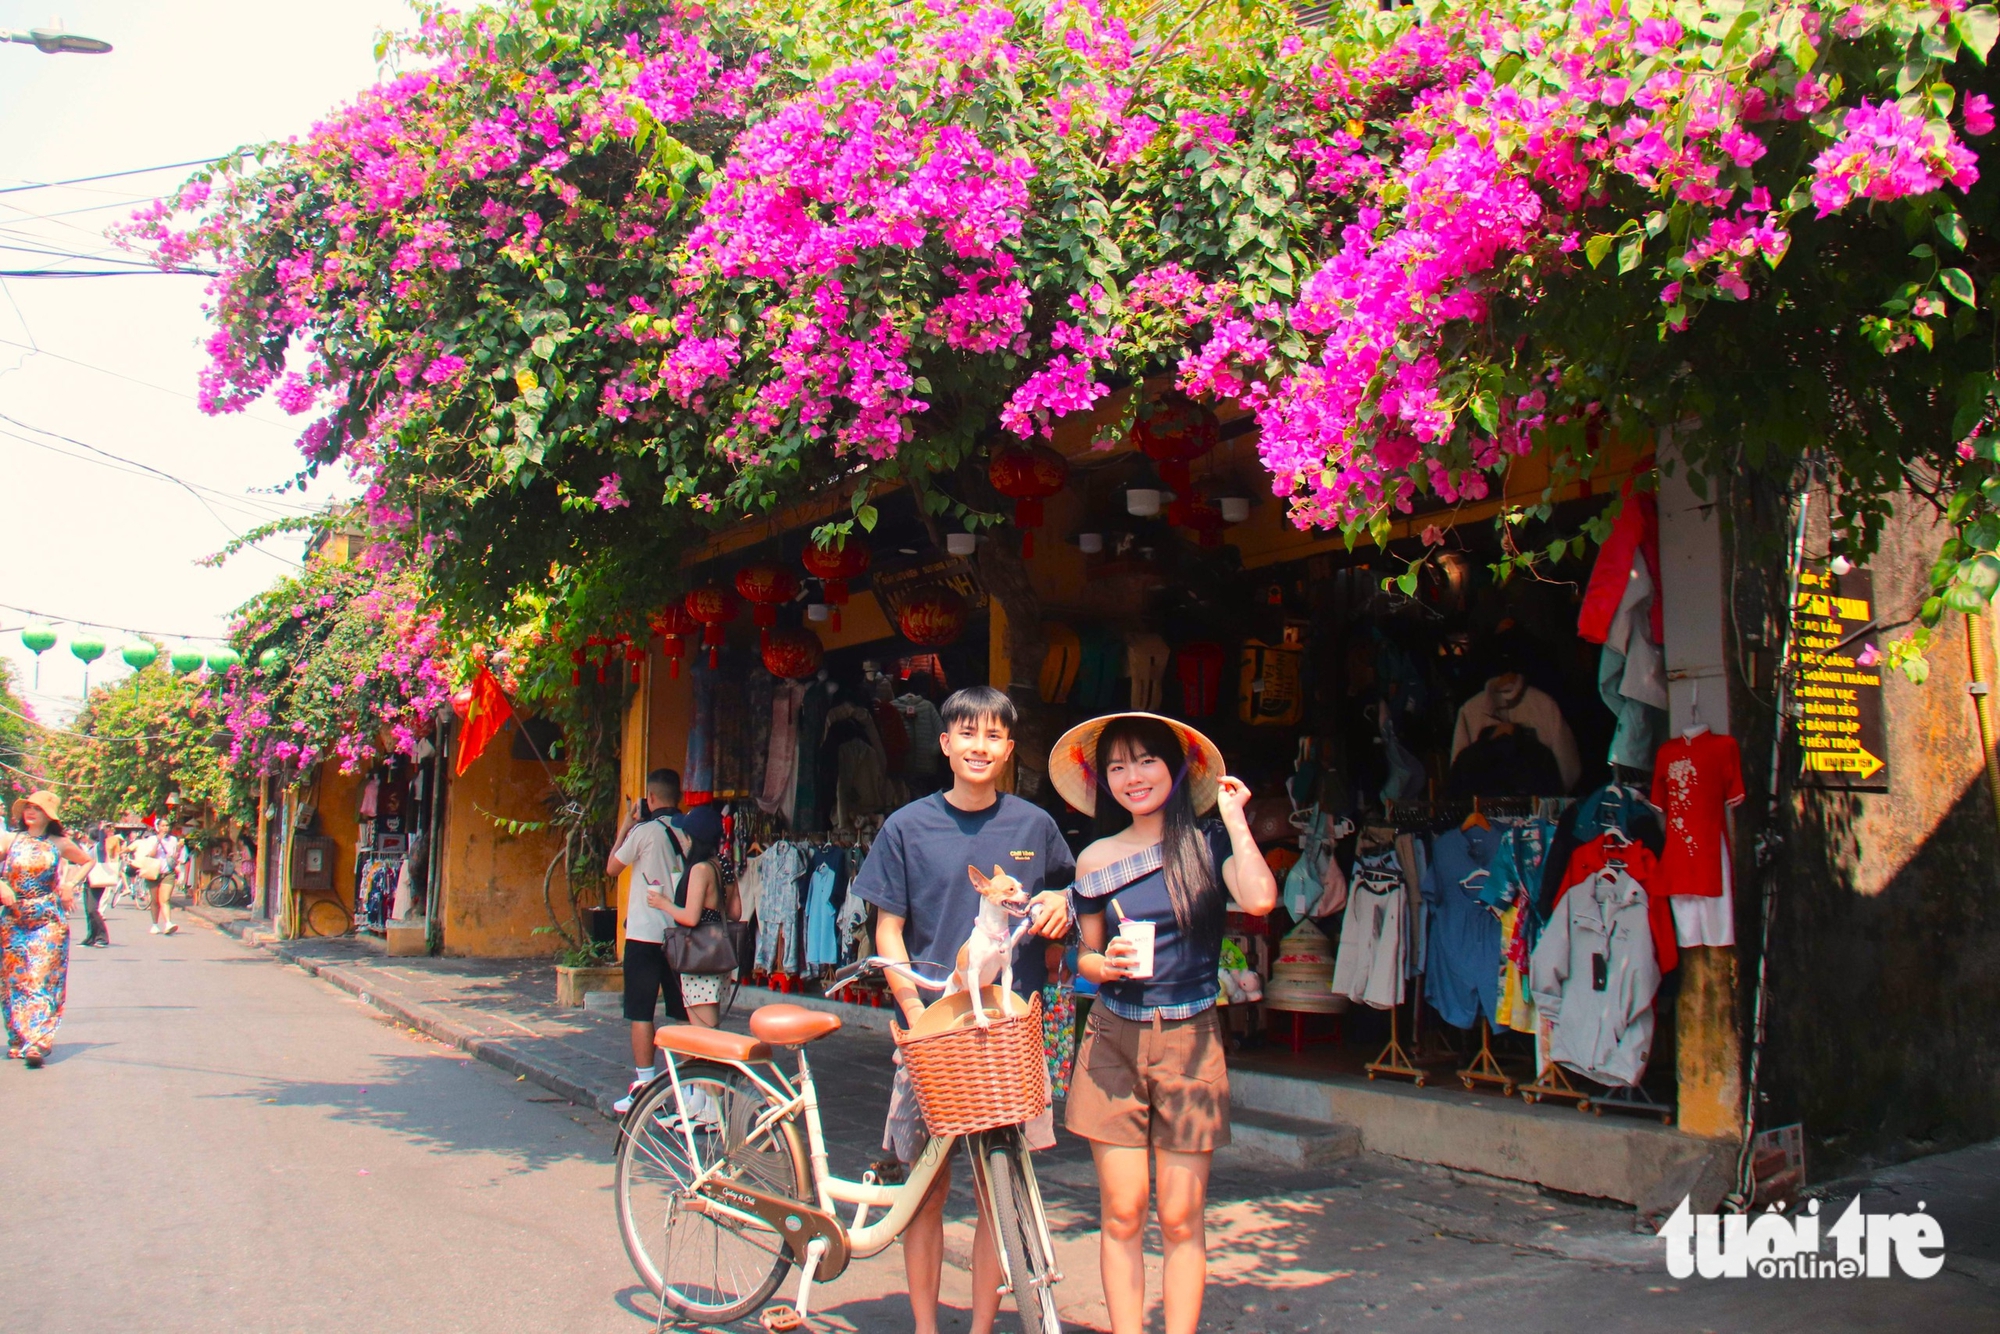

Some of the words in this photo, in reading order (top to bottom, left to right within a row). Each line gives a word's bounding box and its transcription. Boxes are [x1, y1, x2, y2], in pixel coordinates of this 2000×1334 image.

[1797, 620, 1820, 632] CAO
[1804, 684, 1835, 698] BÁNH
[1835, 688, 1857, 702] VẠC
[1805, 700, 1837, 715] BÁNH
[1837, 702, 1859, 717] XÈO
[1806, 717, 1837, 732] BÁNH
[1837, 719, 1861, 735] ĐẬP
[1806, 732, 1830, 748] HẾN
[1830, 735, 1861, 752] TRỘN
